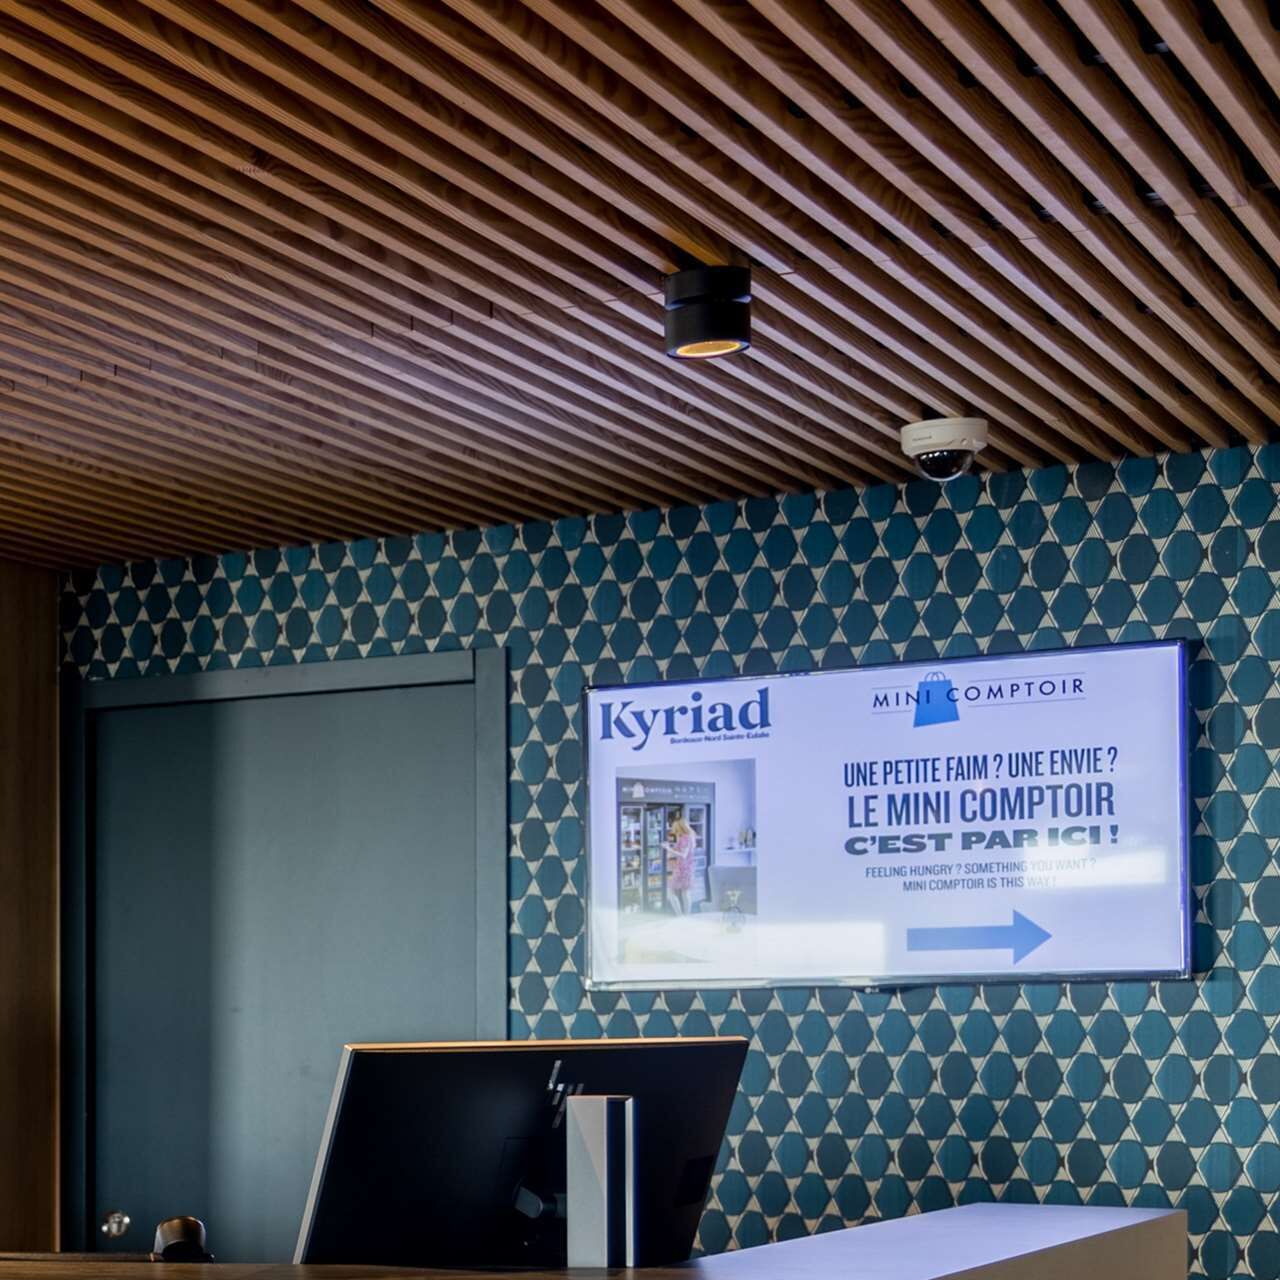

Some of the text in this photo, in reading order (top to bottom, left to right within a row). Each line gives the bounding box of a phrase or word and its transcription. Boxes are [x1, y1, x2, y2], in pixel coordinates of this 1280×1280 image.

[872, 678, 1085, 708] MINI COMPTOIR
[599, 686, 772, 751] Kyriad
[844, 746, 1118, 788] UNE PETITE FAIM ? UNE ENVIE ?
[848, 782, 1115, 829] LE MINI COMPTOIR
[961, 828, 1040, 851] PAR
[1047, 825, 1101, 848] ICI
[1110, 824, 1119, 844] !
[865, 865, 908, 878] FEELING
[909, 863, 954, 877] HUNGRY
[964, 859, 1028, 875] SOMETHING
[903, 879, 927, 892] MINI
[928, 877, 985, 891] COMPTOIR
[987, 877, 997, 889] IS
[1000, 876, 1024, 888] THIS
